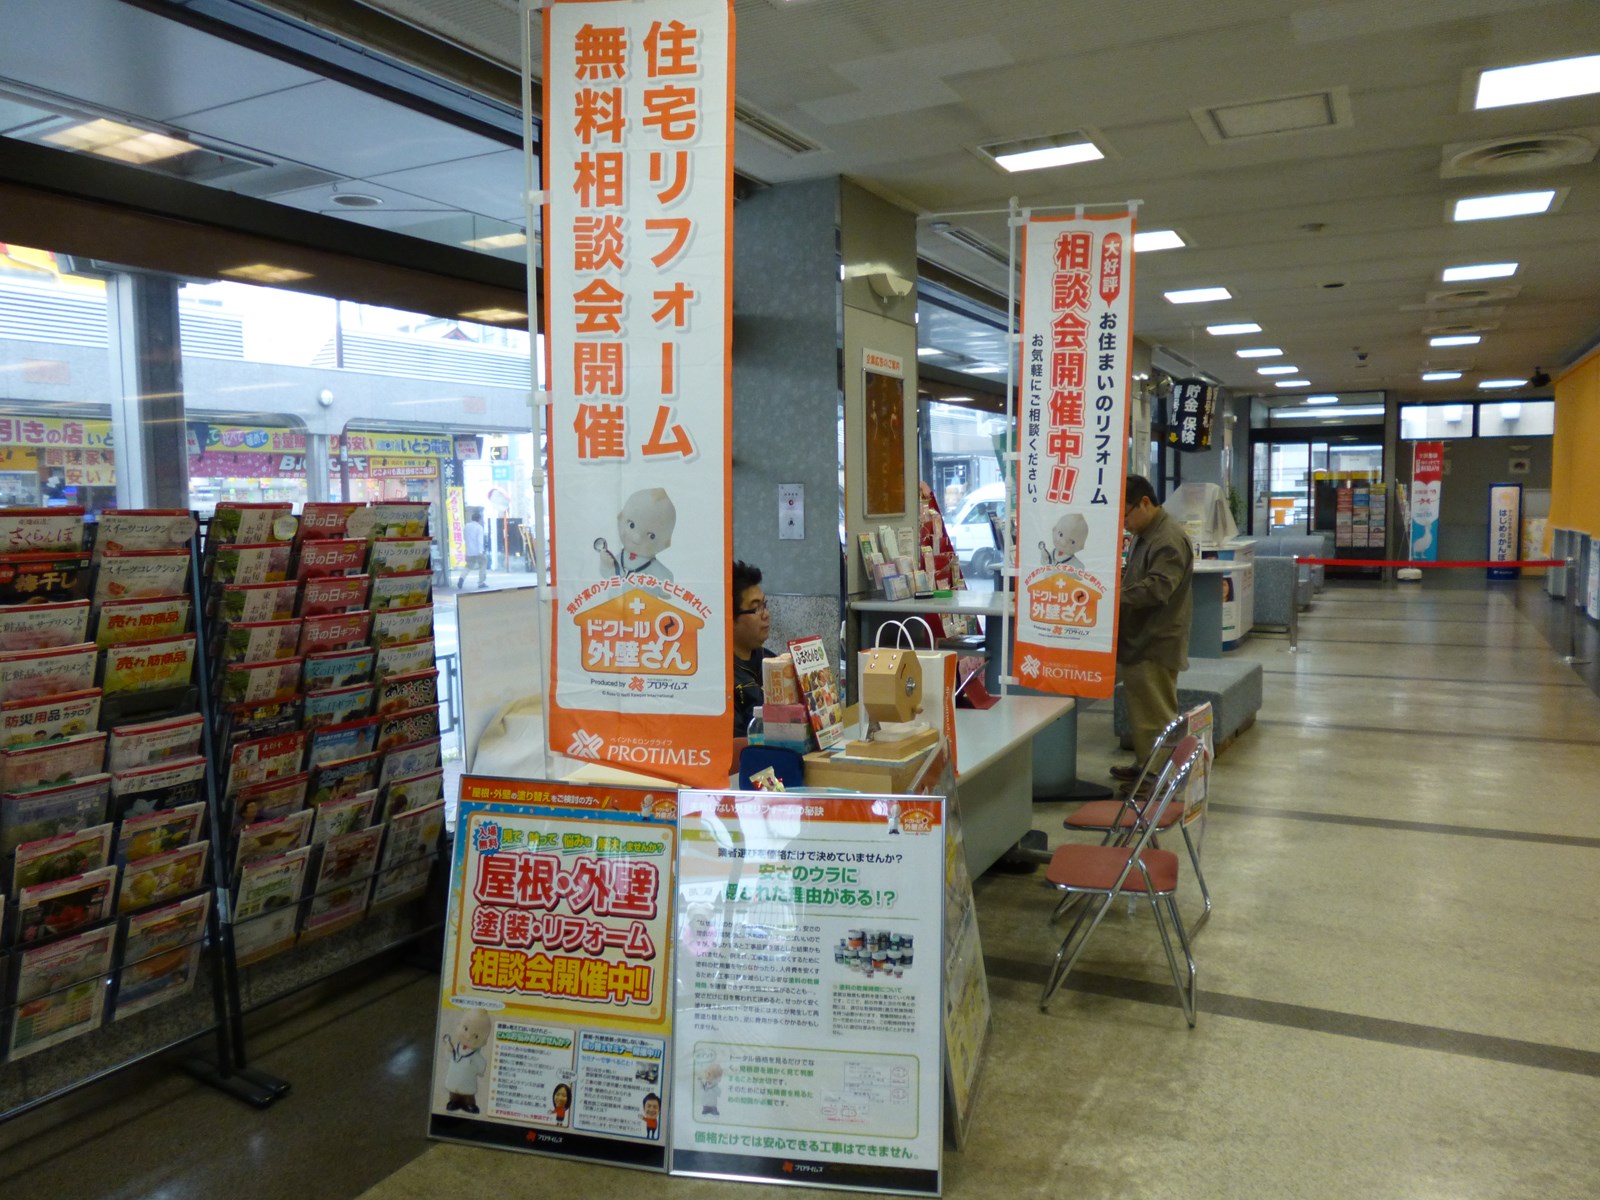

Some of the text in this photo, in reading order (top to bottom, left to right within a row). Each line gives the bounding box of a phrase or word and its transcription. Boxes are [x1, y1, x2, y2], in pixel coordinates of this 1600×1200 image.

[573, 23, 627, 459] 無料相談会開催
[642, 20, 697, 457] 住宅リフォーム
[1102, 240, 1119, 293] 大好評
[1028, 334, 1044, 503] お気軽にご相談ください。
[1090, 312, 1117, 505] お住まいのリフォーム
[303, 551, 358, 566] 母の日ギフト
[14, 571, 78, 593] 梅干し
[307, 588, 361, 603] 母の日ギフト
[1032, 590, 1068, 603] ドクトル
[1032, 602, 1092, 624] 外壁さん
[308, 625, 361, 640] 母の日ギフト
[587, 619, 650, 638] ドクトル
[588, 639, 691, 670] 外壁さん
[590, 678, 618, 688] Produced
[647, 681, 689, 690] プロタイムズ
[4, 707, 93, 728] 防災用品 カタログ
[607, 745, 711, 766] PROTIMES
[478, 824, 498, 838] 入場
[477, 855, 656, 913] 屋根・外壁
[758, 864, 858, 884] 安さのウラに
[473, 909, 652, 956] 塗装・リフォーム
[471, 948, 649, 1001] 相談会開催中!!
[694, 1131, 918, 1160] 価格だけでは安心できる工事はできません。
